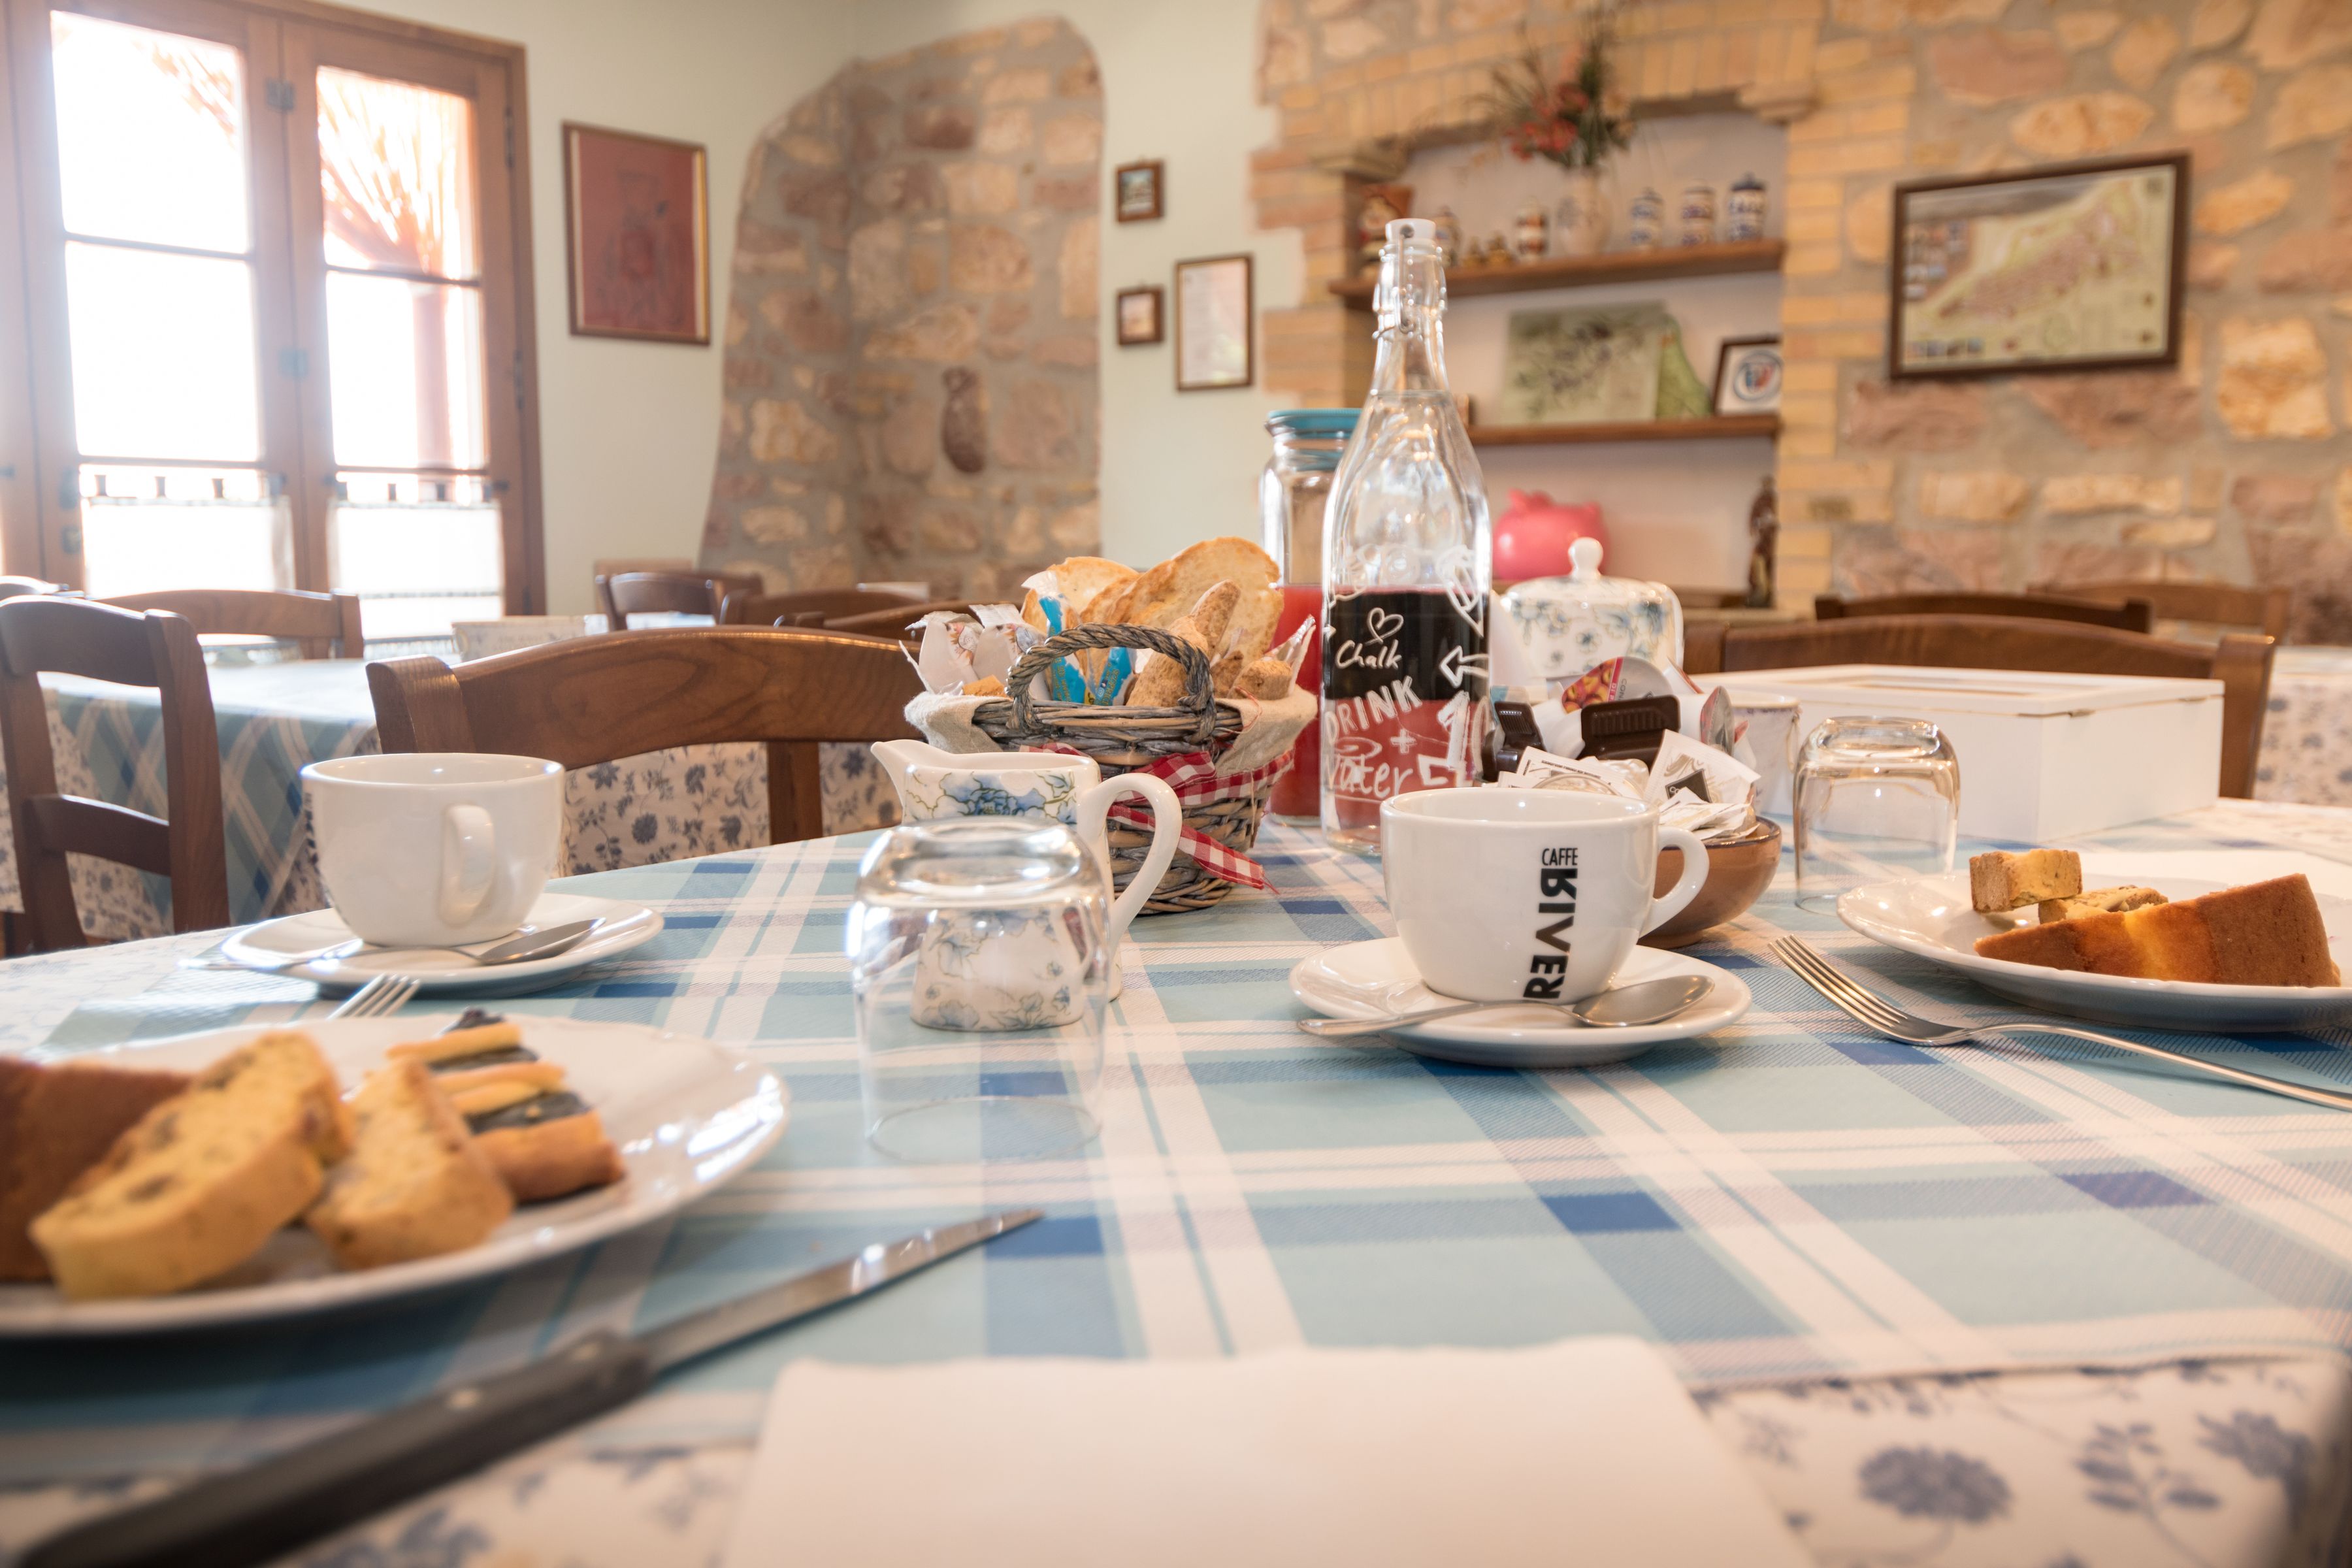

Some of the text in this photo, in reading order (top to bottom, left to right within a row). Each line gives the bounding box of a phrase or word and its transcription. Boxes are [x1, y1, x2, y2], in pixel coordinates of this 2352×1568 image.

[1335, 638, 1403, 670] Chalk
[1324, 676, 1423, 745] DRINK
[1542, 847, 1578, 866] CAFFE
